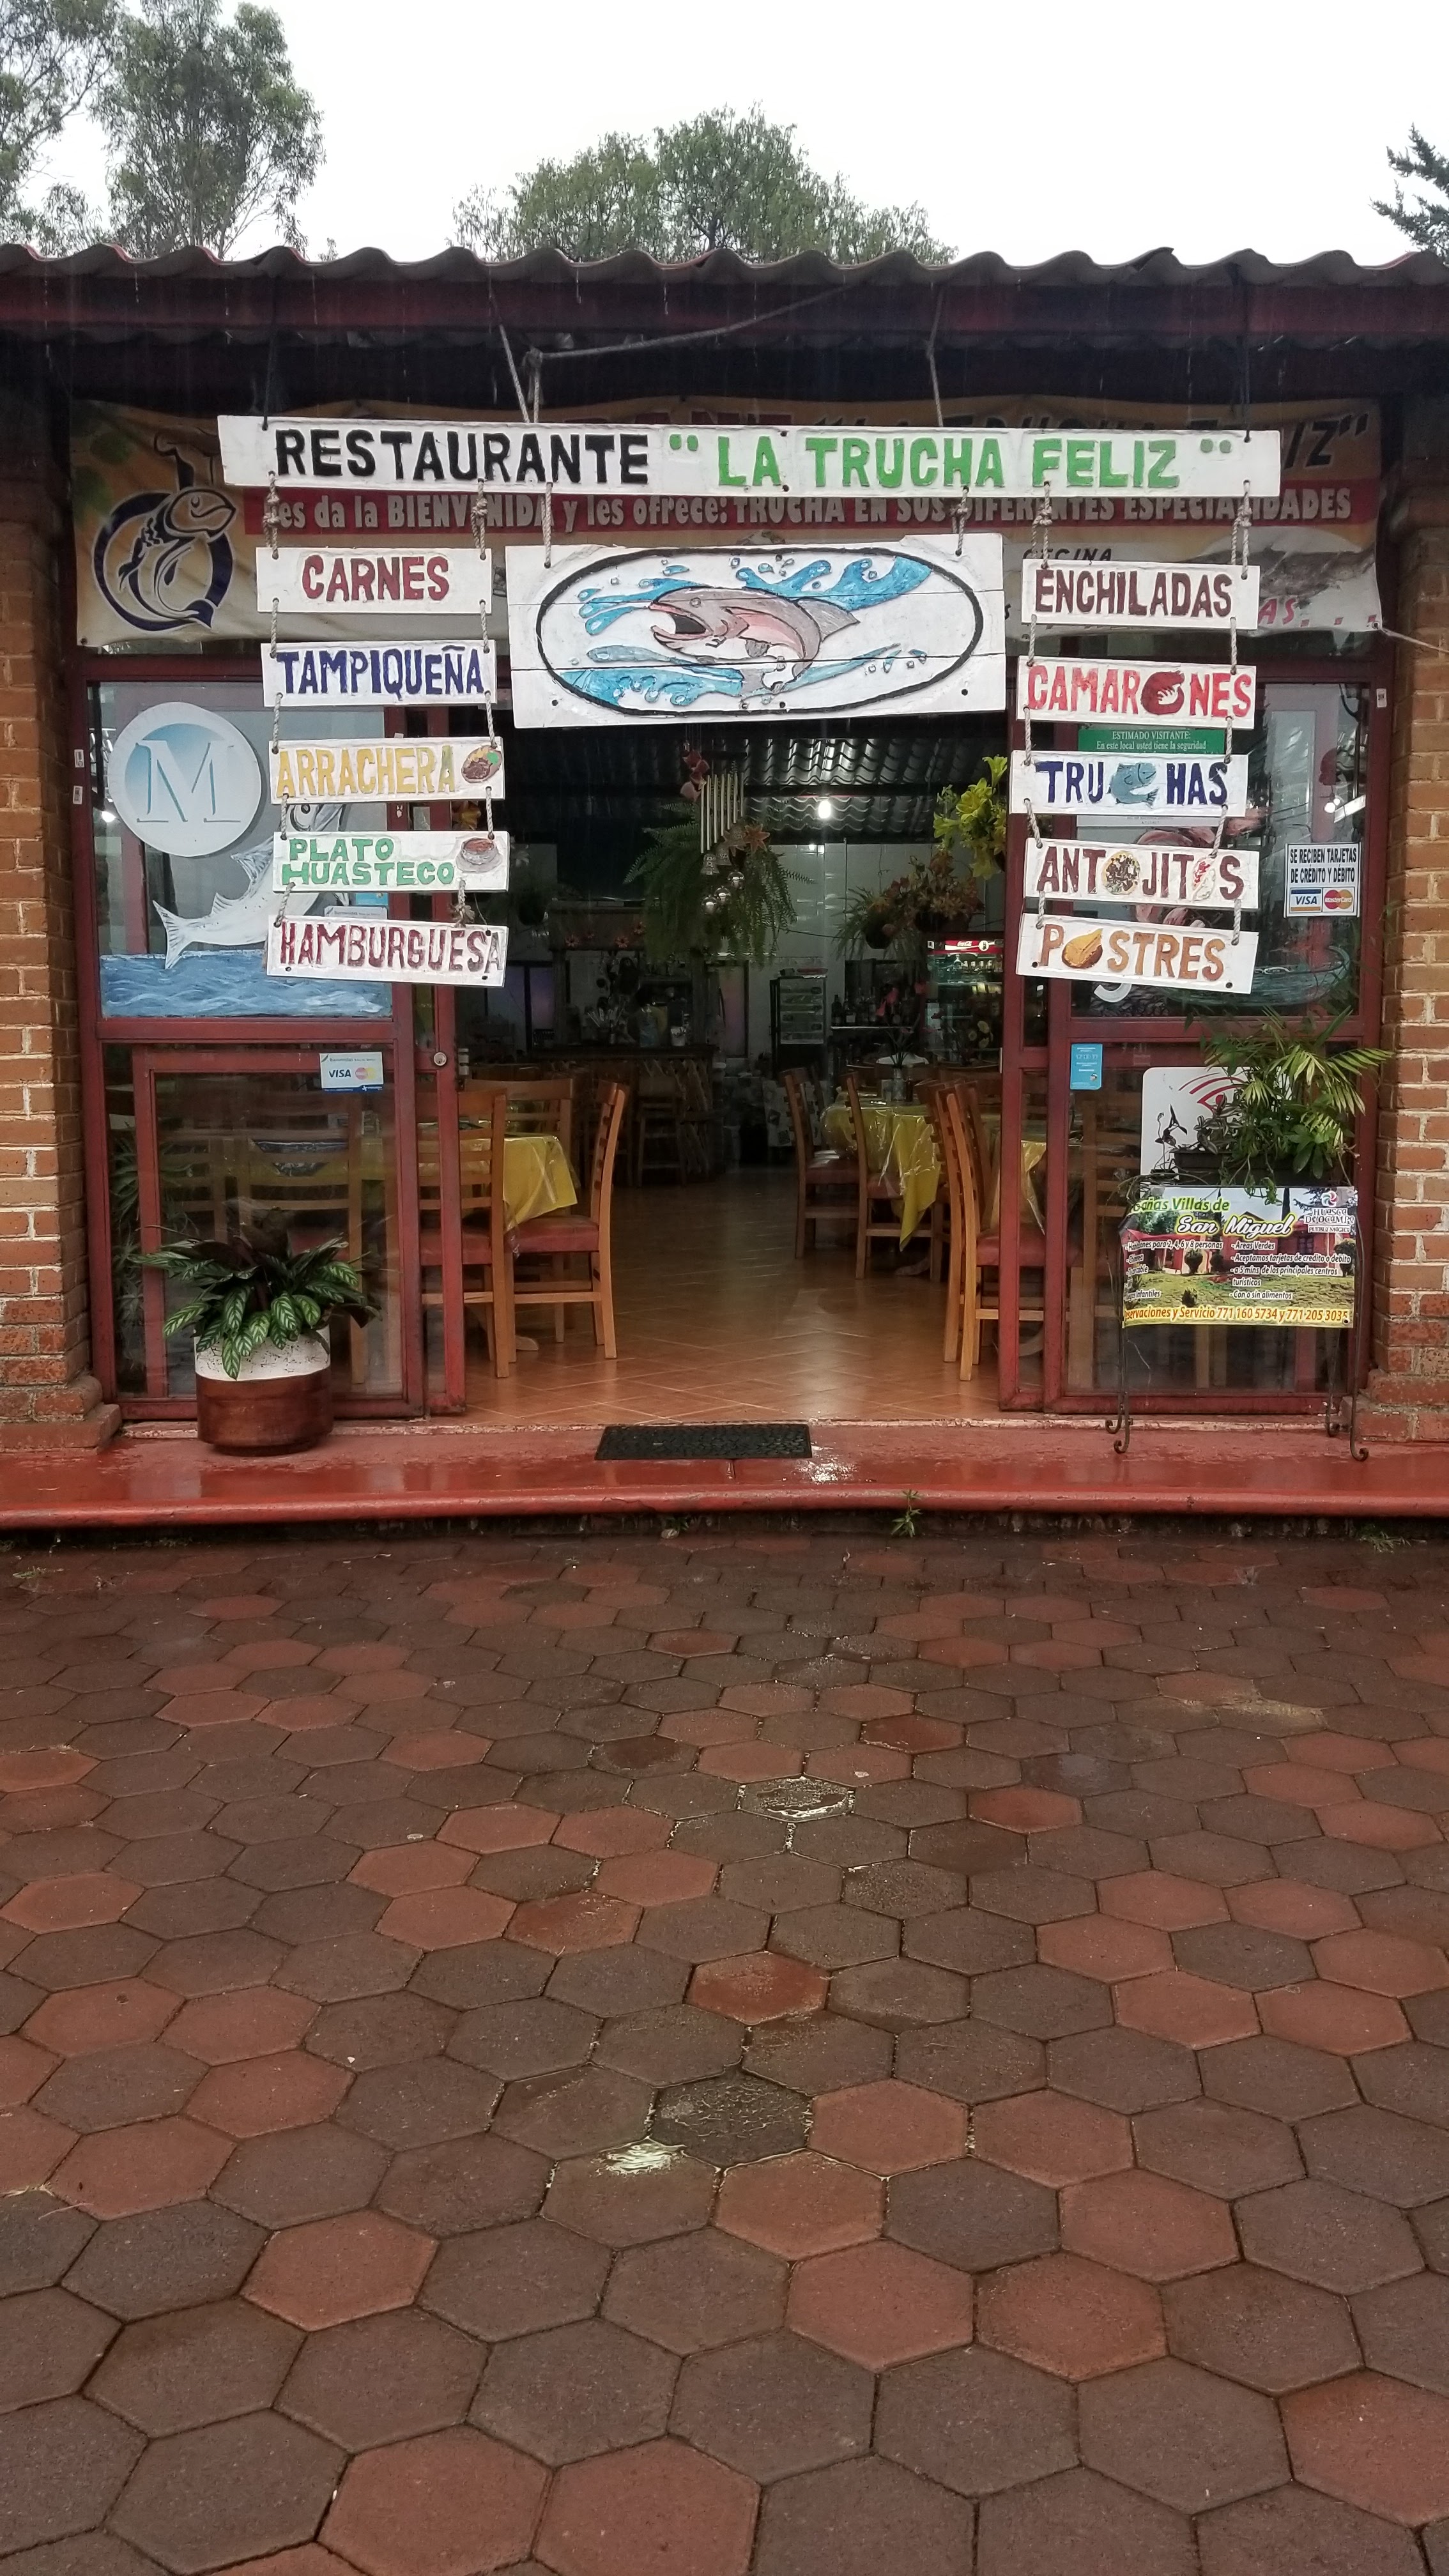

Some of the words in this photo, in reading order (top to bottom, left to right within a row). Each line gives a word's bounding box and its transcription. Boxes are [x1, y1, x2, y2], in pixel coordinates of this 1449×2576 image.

[275, 429, 648, 484] RESTAURANTE
[806, 437, 1004, 488] TRUCHA
[314, 495, 345, 528] da
[355, 495, 378, 528] la
[564, 499, 578, 533] y
[587, 495, 624, 526] les
[633, 496, 727, 525] ofrece:
[734, 497, 847, 523] TRUCHA
[855, 497, 887, 523] EN
[302, 555, 450, 602] CARNES
[1036, 568, 1232, 617] ENCHILADAS
[277, 645, 484, 700] TAMPIQUEÑA
[1112, 731, 1150, 740] ESTIMADO
[1151, 731, 1191, 740] VISITANTE:
[1096, 741, 1105, 749] En
[1120, 740, 1135, 750] local
[1136, 741, 1153, 749] usted
[1154, 741, 1169, 749] tiene
[1170, 741, 1176, 749] la
[1177, 741, 1206, 751] seguridad
[275, 745, 456, 798] ARRACHERA
[289, 838, 394, 861] PLATO
[1290, 848, 1298, 864] SE
[1299, 848, 1325, 864] RECIBEN
[1327, 847, 1357, 863] TARJETAS
[281, 861, 455, 885] HUASTECO
[1291, 868, 1298, 884] DE
[1300, 864, 1326, 883] CRÉDITO
[1328, 868, 1332, 883] Y
[1333, 863, 1355, 882] DÉBITO
[1295, 896, 1317, 905] VISA
[280, 923, 503, 974] HAMBURGUESA
[328, 1069, 351, 1078] VISA
[1172, 1197, 1209, 1211] Villas
[1212, 1197, 1229, 1211] de
[1177, 1216, 1217, 1234] San
[1225, 1214, 1294, 1239] Miguel
[1153, 1242, 1167, 1250] para
[1235, 1255, 1269, 1263] Aceptamos
[1270, 1254, 1293, 1263] tarjetas
[1280, 1266, 1314, 1275] principales
[1136, 1289, 1161, 1298] Infantiles
[1172, 1308, 1177, 1321] y
[1179, 1306, 1215, 1318] Servicio
[1217, 1308, 1233, 1319] 771
[1237, 1308, 1253, 1319] 160
[1255, 1308, 1277, 1319] 5734
[1278, 1310, 1285, 1322] y
[1287, 1310, 1303, 1320] 771
[1306, 1310, 1323, 1321] 205
